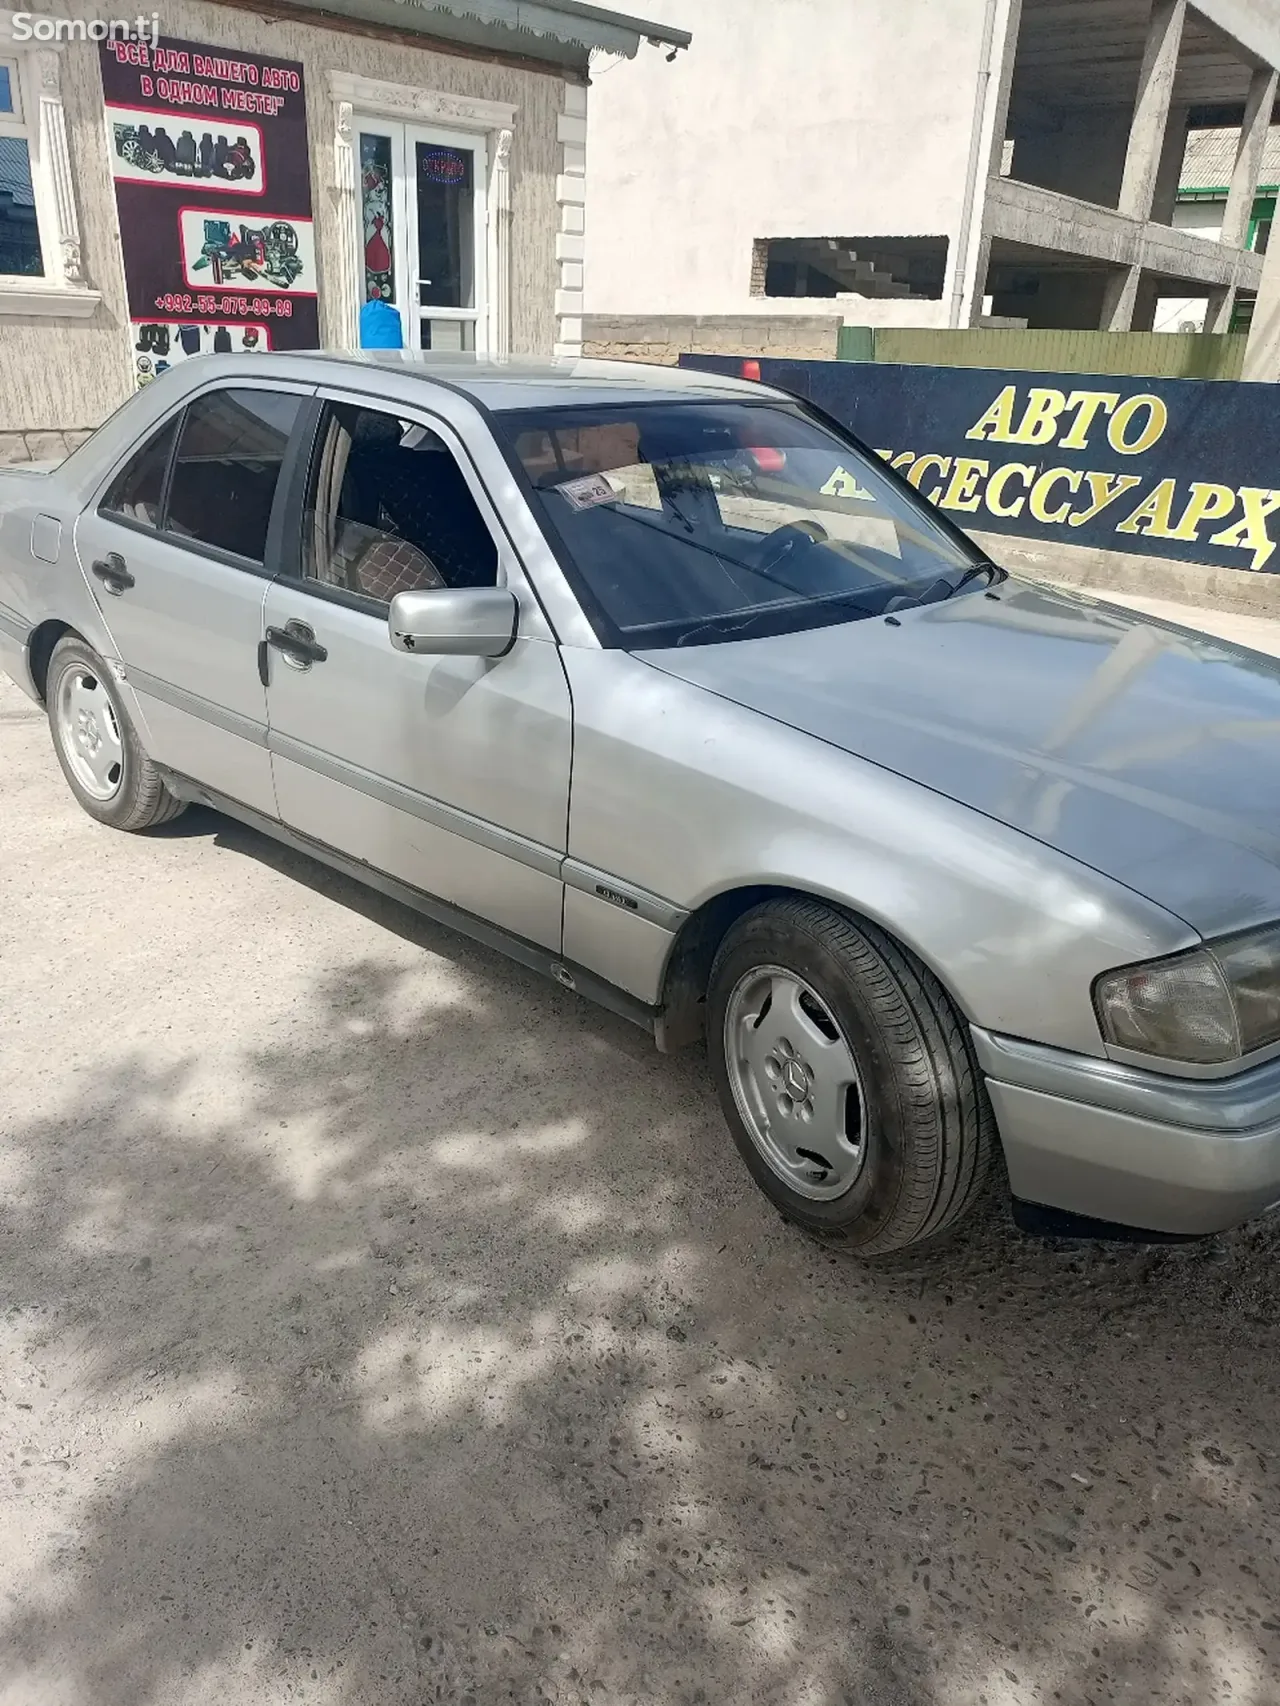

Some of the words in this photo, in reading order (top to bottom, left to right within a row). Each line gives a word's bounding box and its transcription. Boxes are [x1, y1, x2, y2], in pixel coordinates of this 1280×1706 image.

[153, 48, 190, 74] ДЛЯ
[193, 54, 259, 85] ВАШЕГО
[262, 67, 300, 92] АВТО
[140, 75, 154, 97] В
[157, 77, 219, 107] ОДНОМ
[221, 88, 285, 116] МЕСТЕ!"
[154, 293, 293, 317] +992-55-075-99-89
[965, 385, 1168, 456] АВТО
